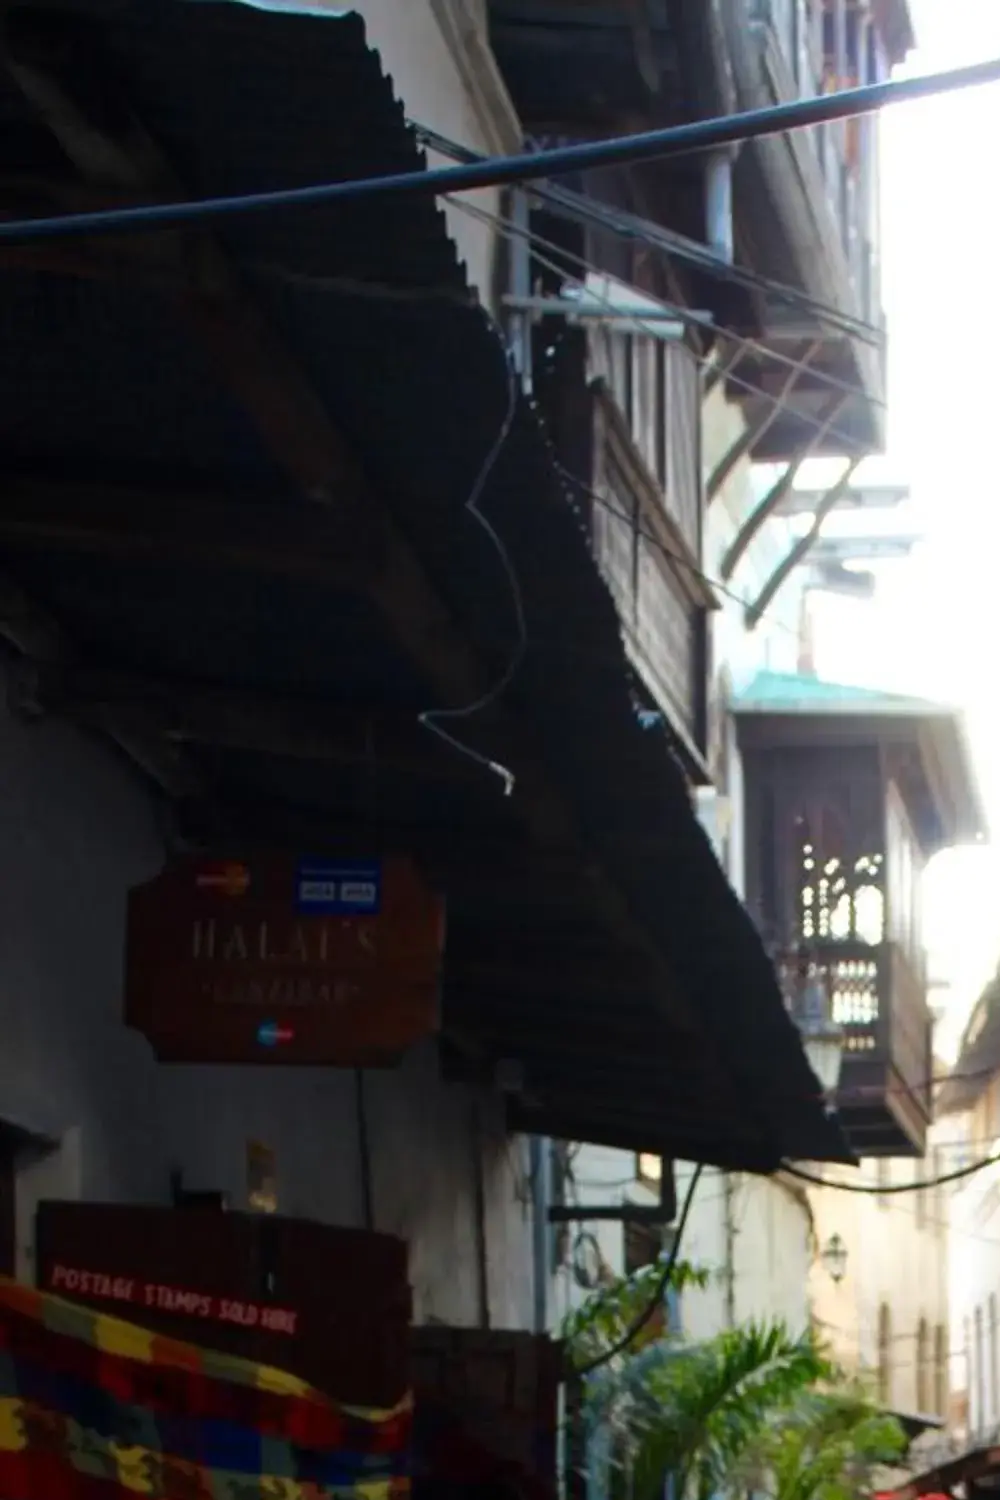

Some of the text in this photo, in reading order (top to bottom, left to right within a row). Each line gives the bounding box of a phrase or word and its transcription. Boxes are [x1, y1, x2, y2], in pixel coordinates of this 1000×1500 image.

[52, 1263, 136, 1300] POSTAGE
[144, 1283, 212, 1318] STAMPS
[218, 1298, 258, 1327] SOLD
